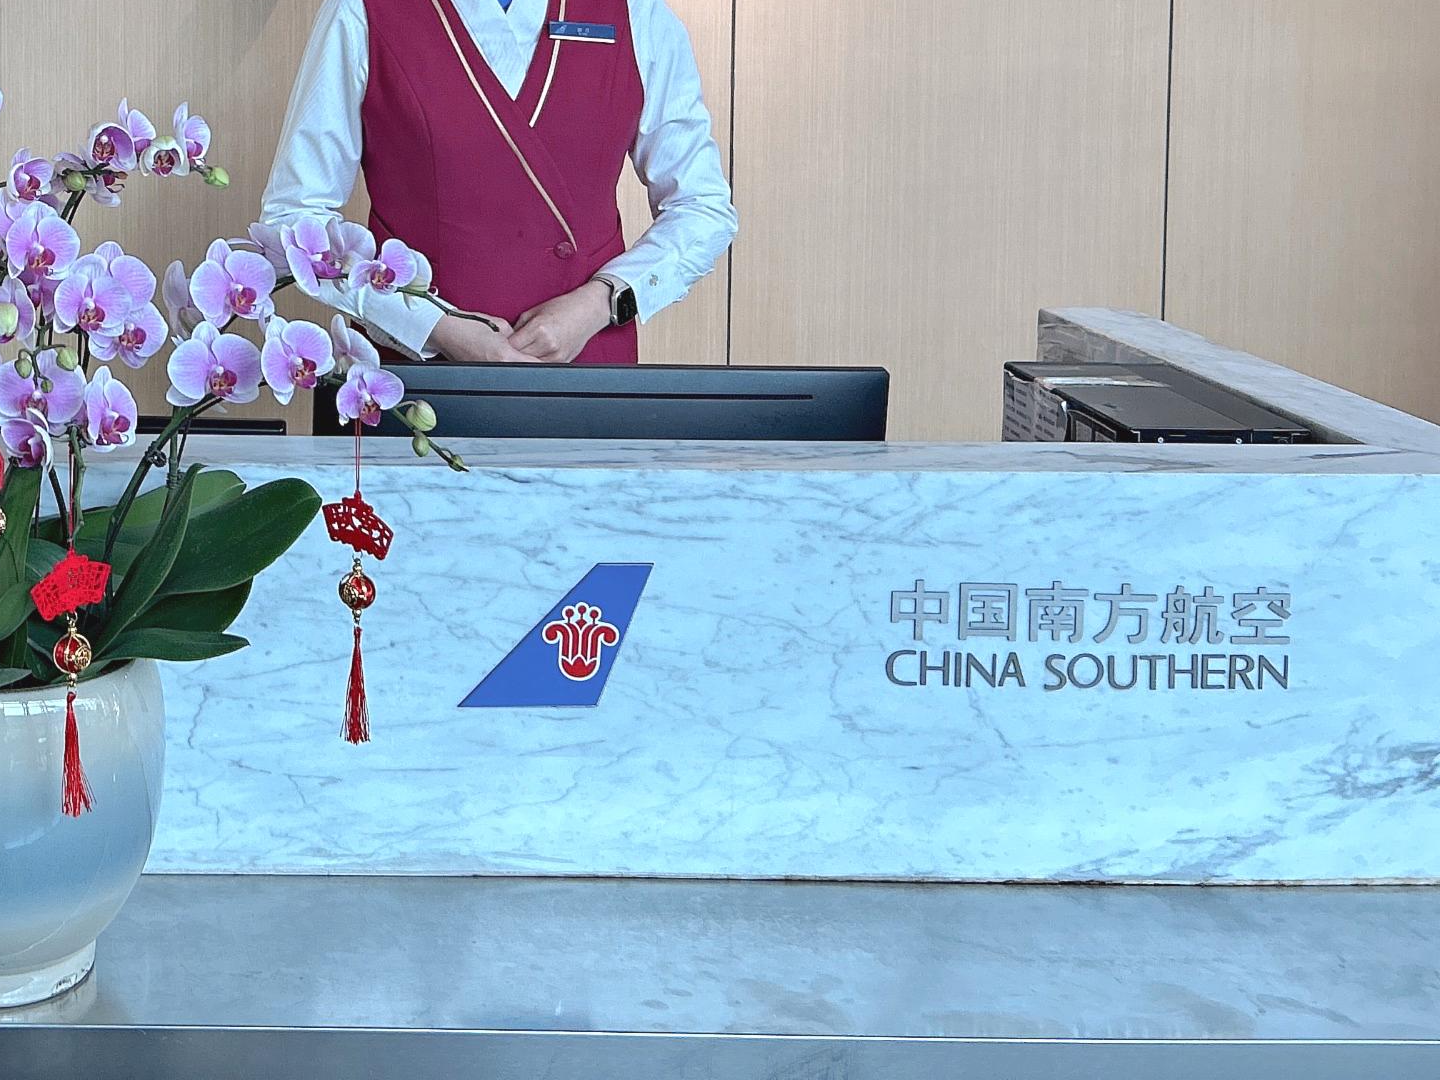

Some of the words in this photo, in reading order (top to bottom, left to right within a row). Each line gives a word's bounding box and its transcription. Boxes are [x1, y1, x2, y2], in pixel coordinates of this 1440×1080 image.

[890, 578, 1291, 645] 中国南方航空
[884, 649, 1027, 689] CHINA
[1043, 652, 1290, 691] SOUTHERN
